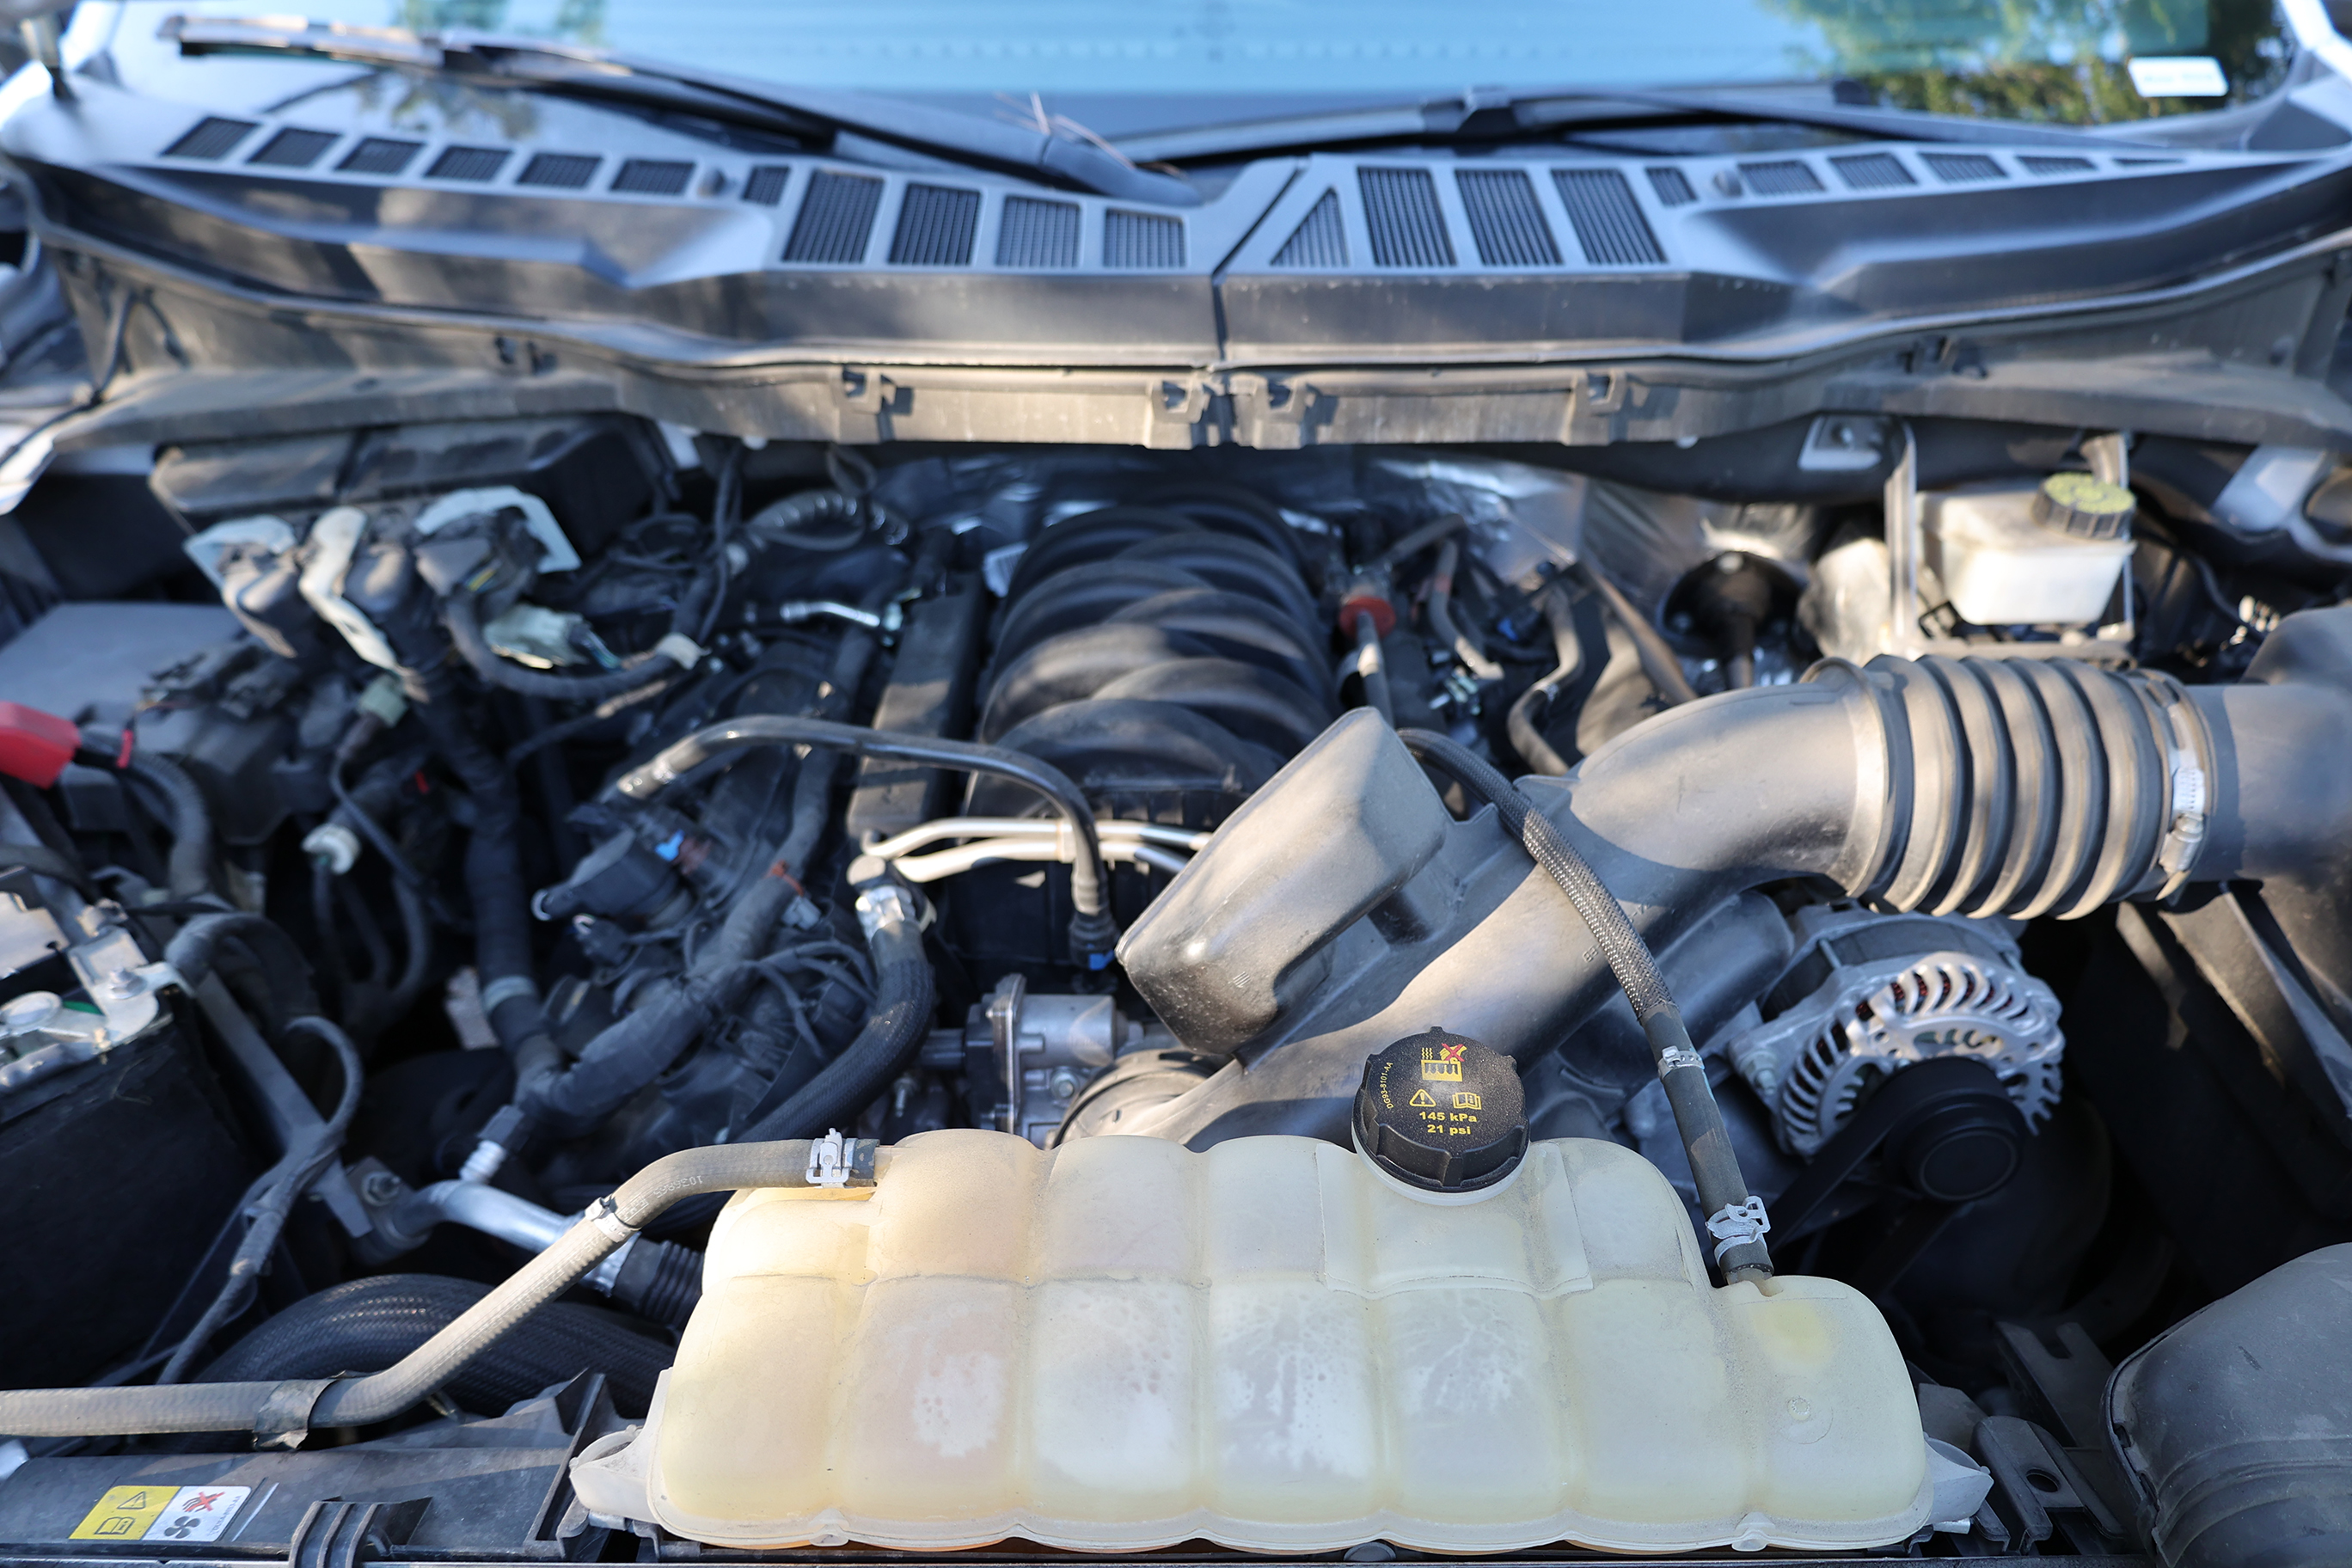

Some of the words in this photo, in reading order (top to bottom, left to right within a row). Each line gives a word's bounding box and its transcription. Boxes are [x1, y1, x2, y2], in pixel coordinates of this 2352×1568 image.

[1380, 1062, 1393, 1109] DG93-8101-AA
[1419, 1112, 1445, 1121] 145
[1450, 1113, 1477, 1123] kPa
[1427, 1124, 1444, 1133] 21
[1449, 1126, 1471, 1136] psi
